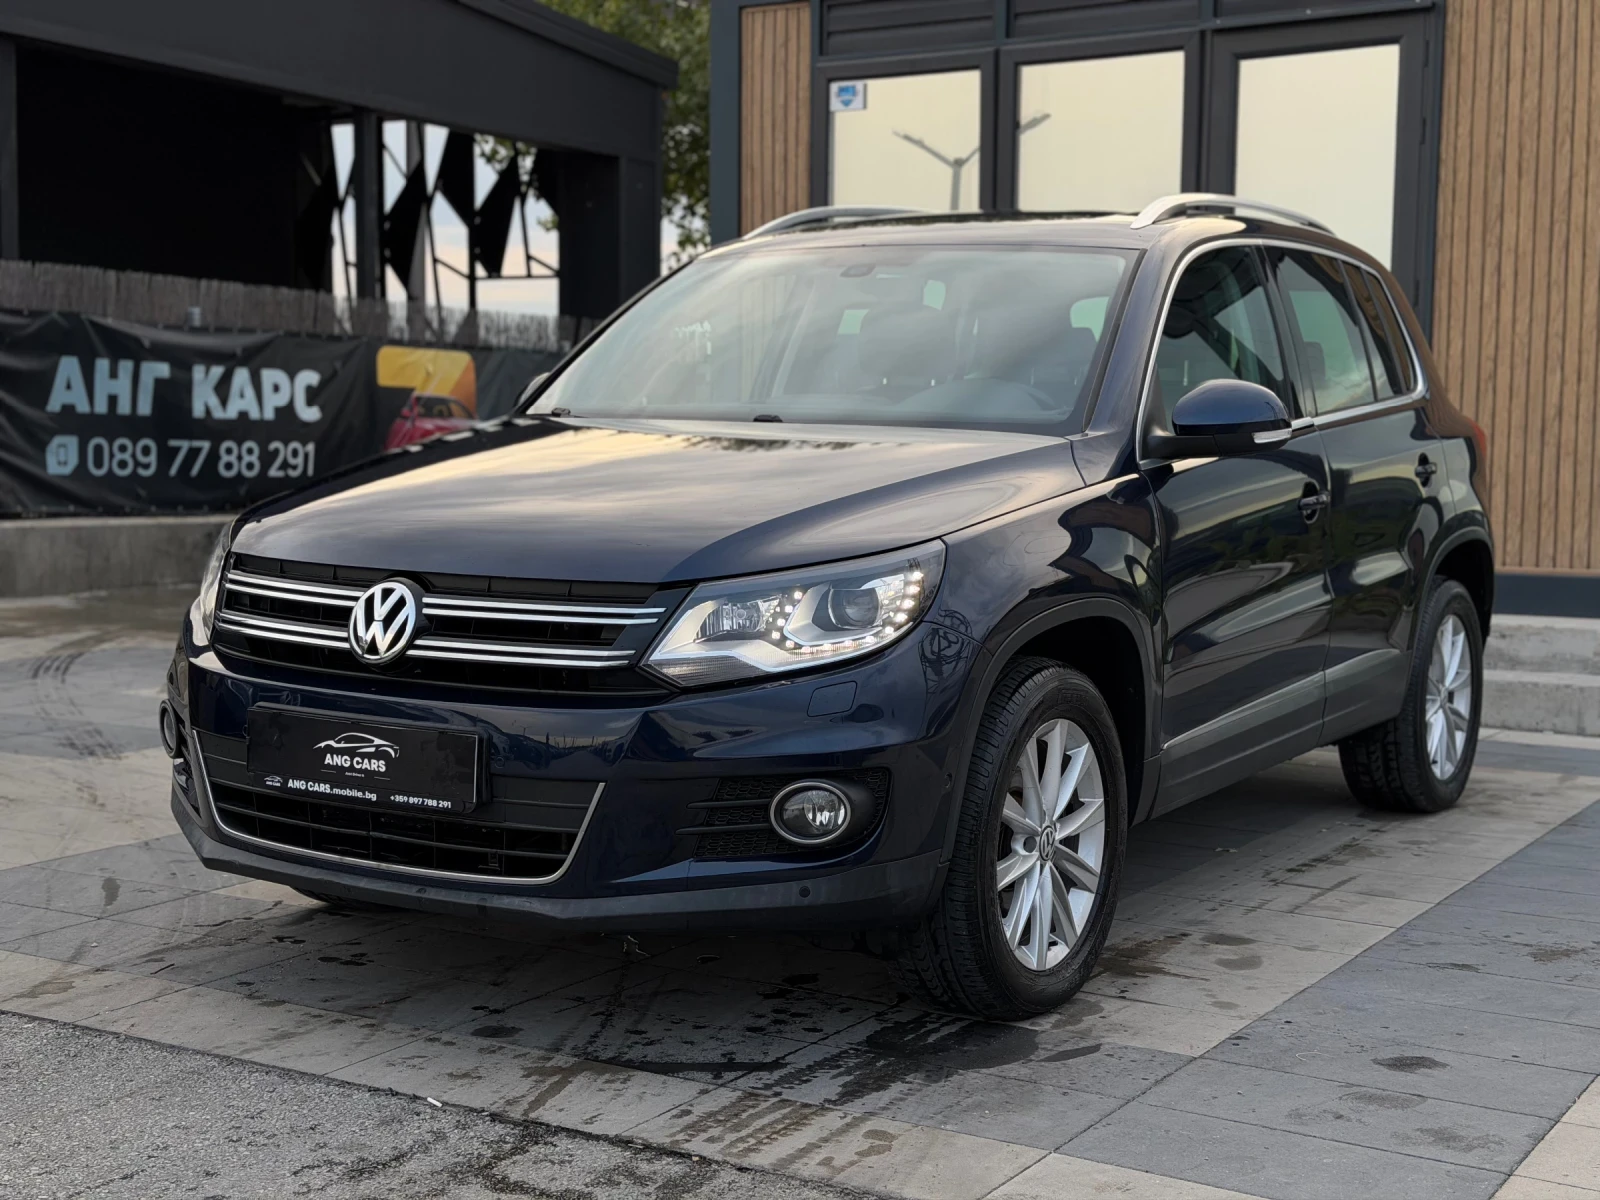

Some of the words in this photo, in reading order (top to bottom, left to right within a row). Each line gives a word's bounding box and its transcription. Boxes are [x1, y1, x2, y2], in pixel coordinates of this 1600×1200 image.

[45, 355, 171, 416] АНГ
[192, 363, 322, 422] КАРС
[87, 436, 158, 477] 089
[167, 438, 211, 478] 77
[218, 440, 261, 478] 88
[267, 440, 315, 478] 291
[324, 753, 351, 767] ANG
[353, 756, 386, 772] CARS
[288, 778, 306, 790] ANG
[307, 781, 377, 801] CARS.mobile.bg
[390, 794, 408, 803] +359
[409, 796, 422, 805] 897
[423, 798, 437, 807] 788
[438, 800, 452, 809] 291
